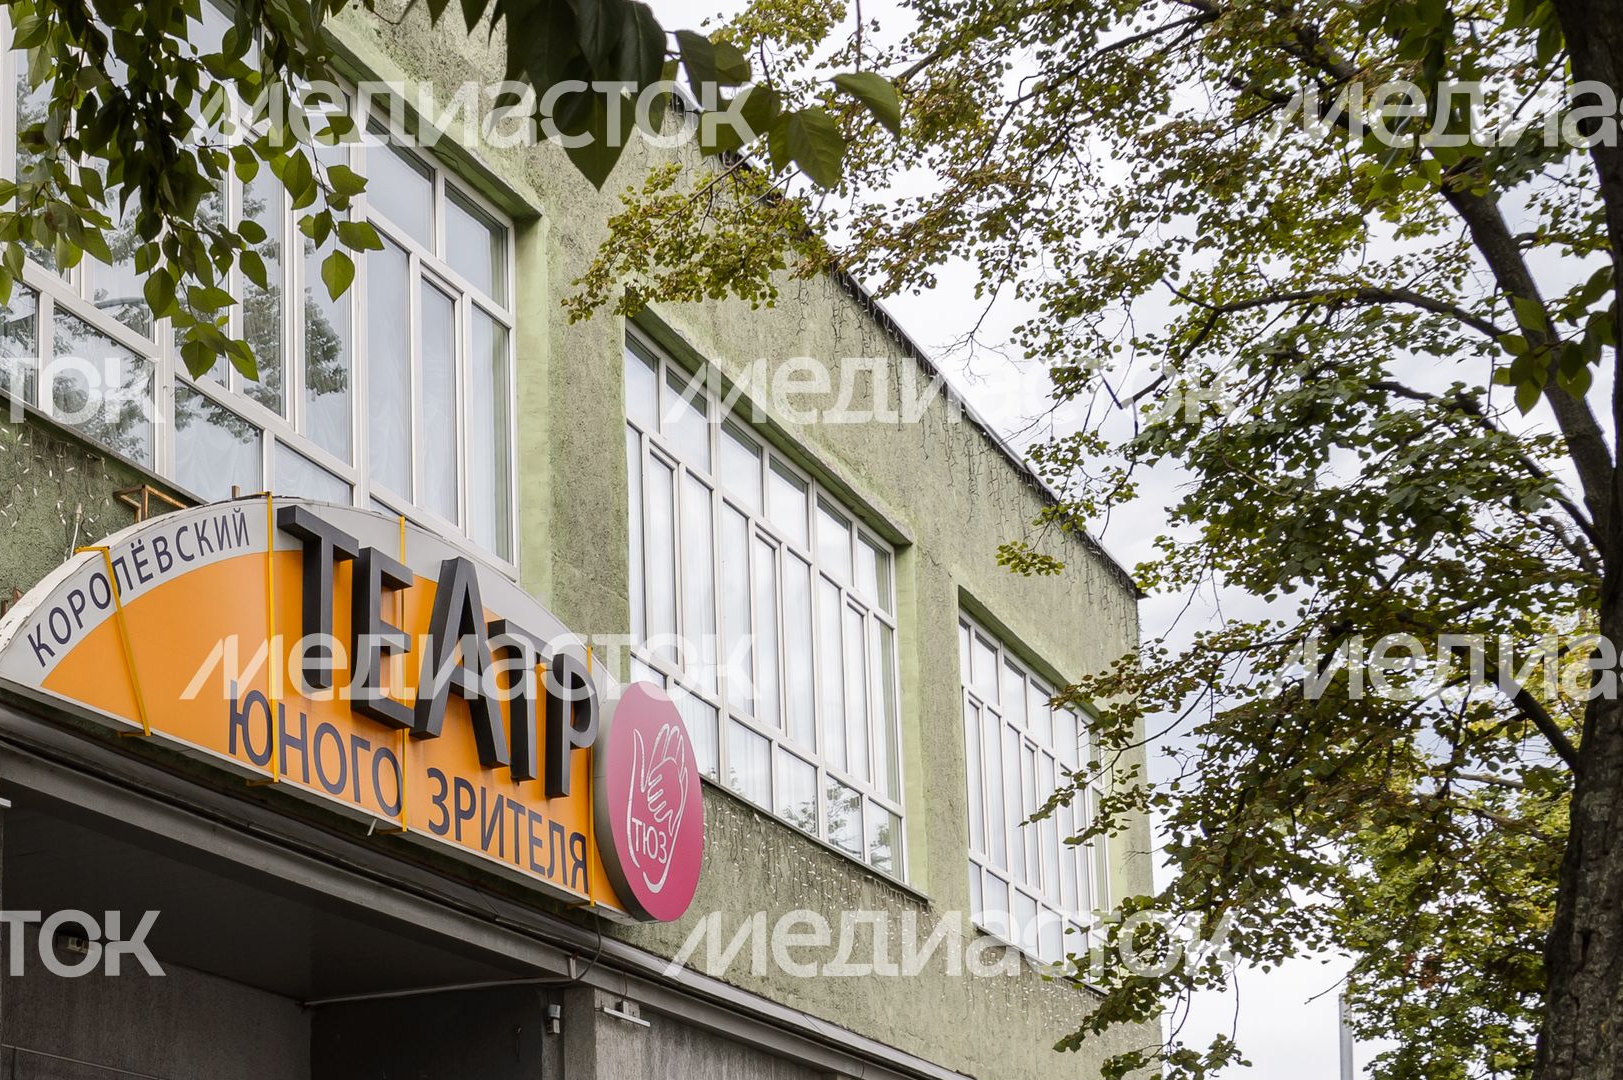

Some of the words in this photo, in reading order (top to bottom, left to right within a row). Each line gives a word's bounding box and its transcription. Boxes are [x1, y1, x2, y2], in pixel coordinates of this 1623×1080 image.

[26, 505, 252, 668] КОРОЛЁВСКИЙ
[228, 680, 404, 818] ЮНОГО
[427, 767, 590, 894] ЗРИТЕЛЯ
[632, 817, 668, 864] ТЮЗ
